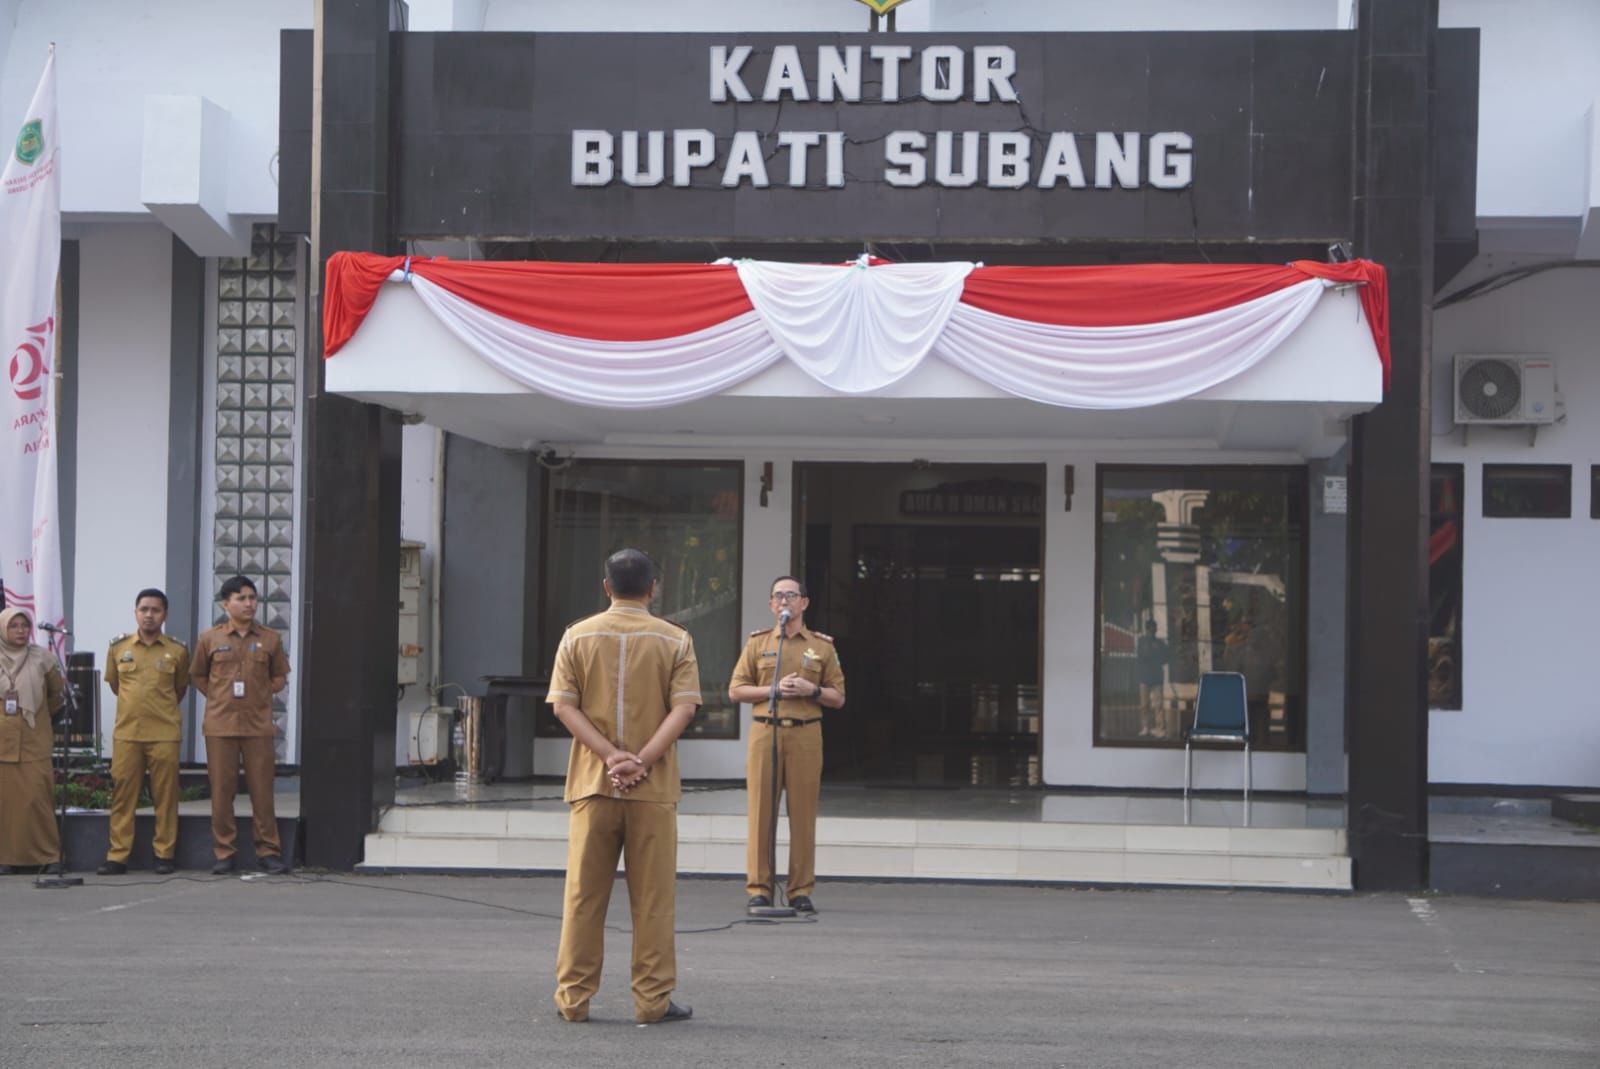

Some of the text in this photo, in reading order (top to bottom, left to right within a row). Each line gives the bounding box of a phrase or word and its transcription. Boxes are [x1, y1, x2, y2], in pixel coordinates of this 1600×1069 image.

[710, 45, 1018, 102] KANTOR
[571, 129, 1193, 190] BUPATI SUBANG
